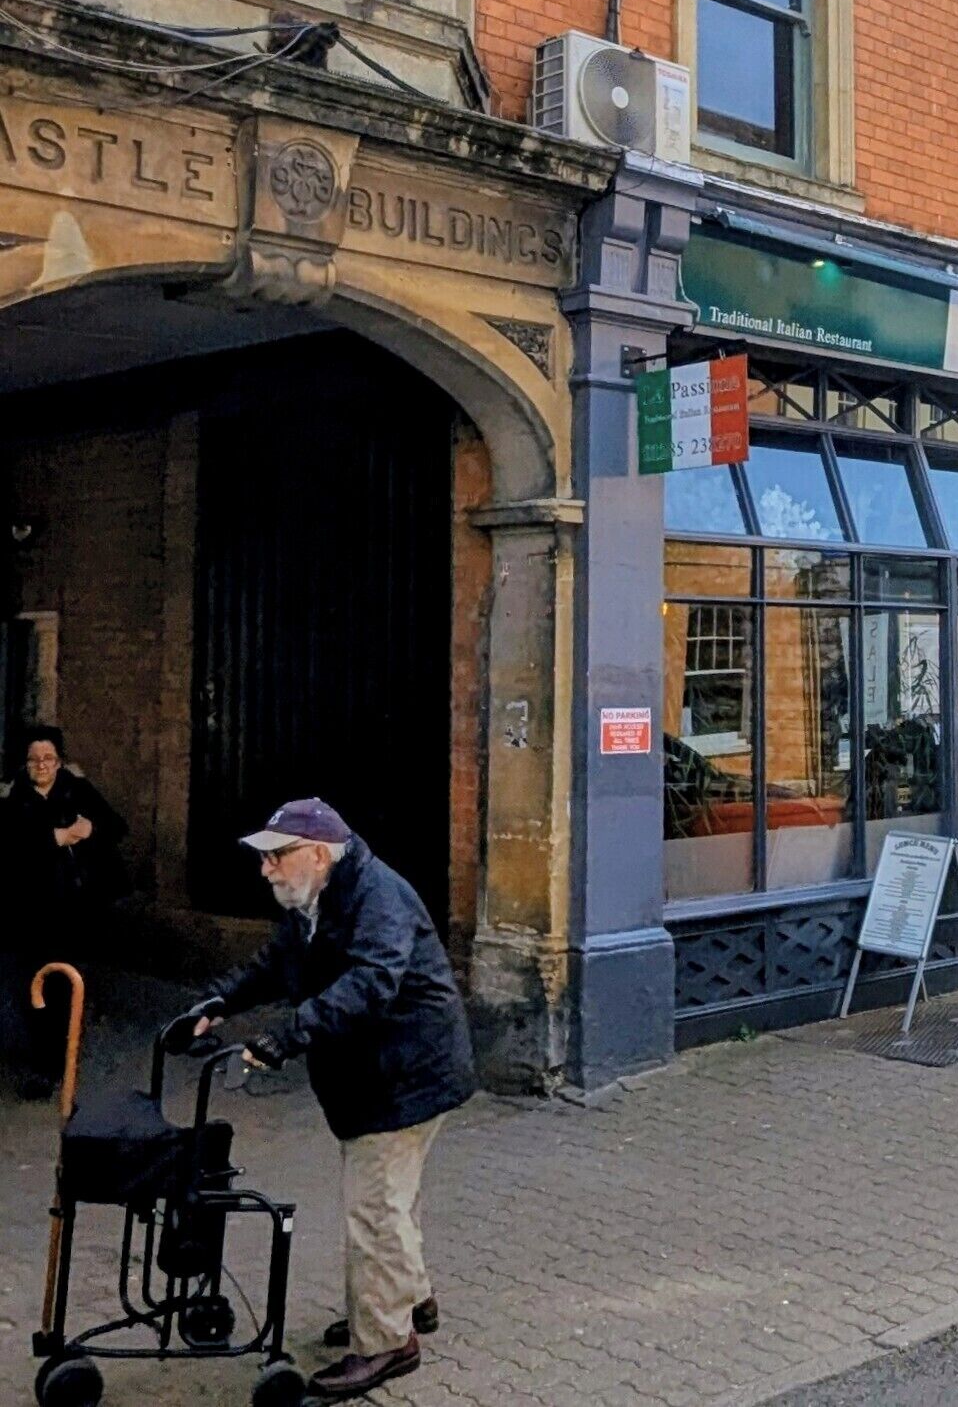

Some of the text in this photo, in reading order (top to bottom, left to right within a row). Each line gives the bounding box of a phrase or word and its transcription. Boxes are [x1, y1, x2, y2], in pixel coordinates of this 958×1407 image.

[349, 186, 565, 265] BUILDINGS
[708, 306, 873, 352] Traditional Italian Restaurant
[602, 710, 650, 720] NO PARKING
